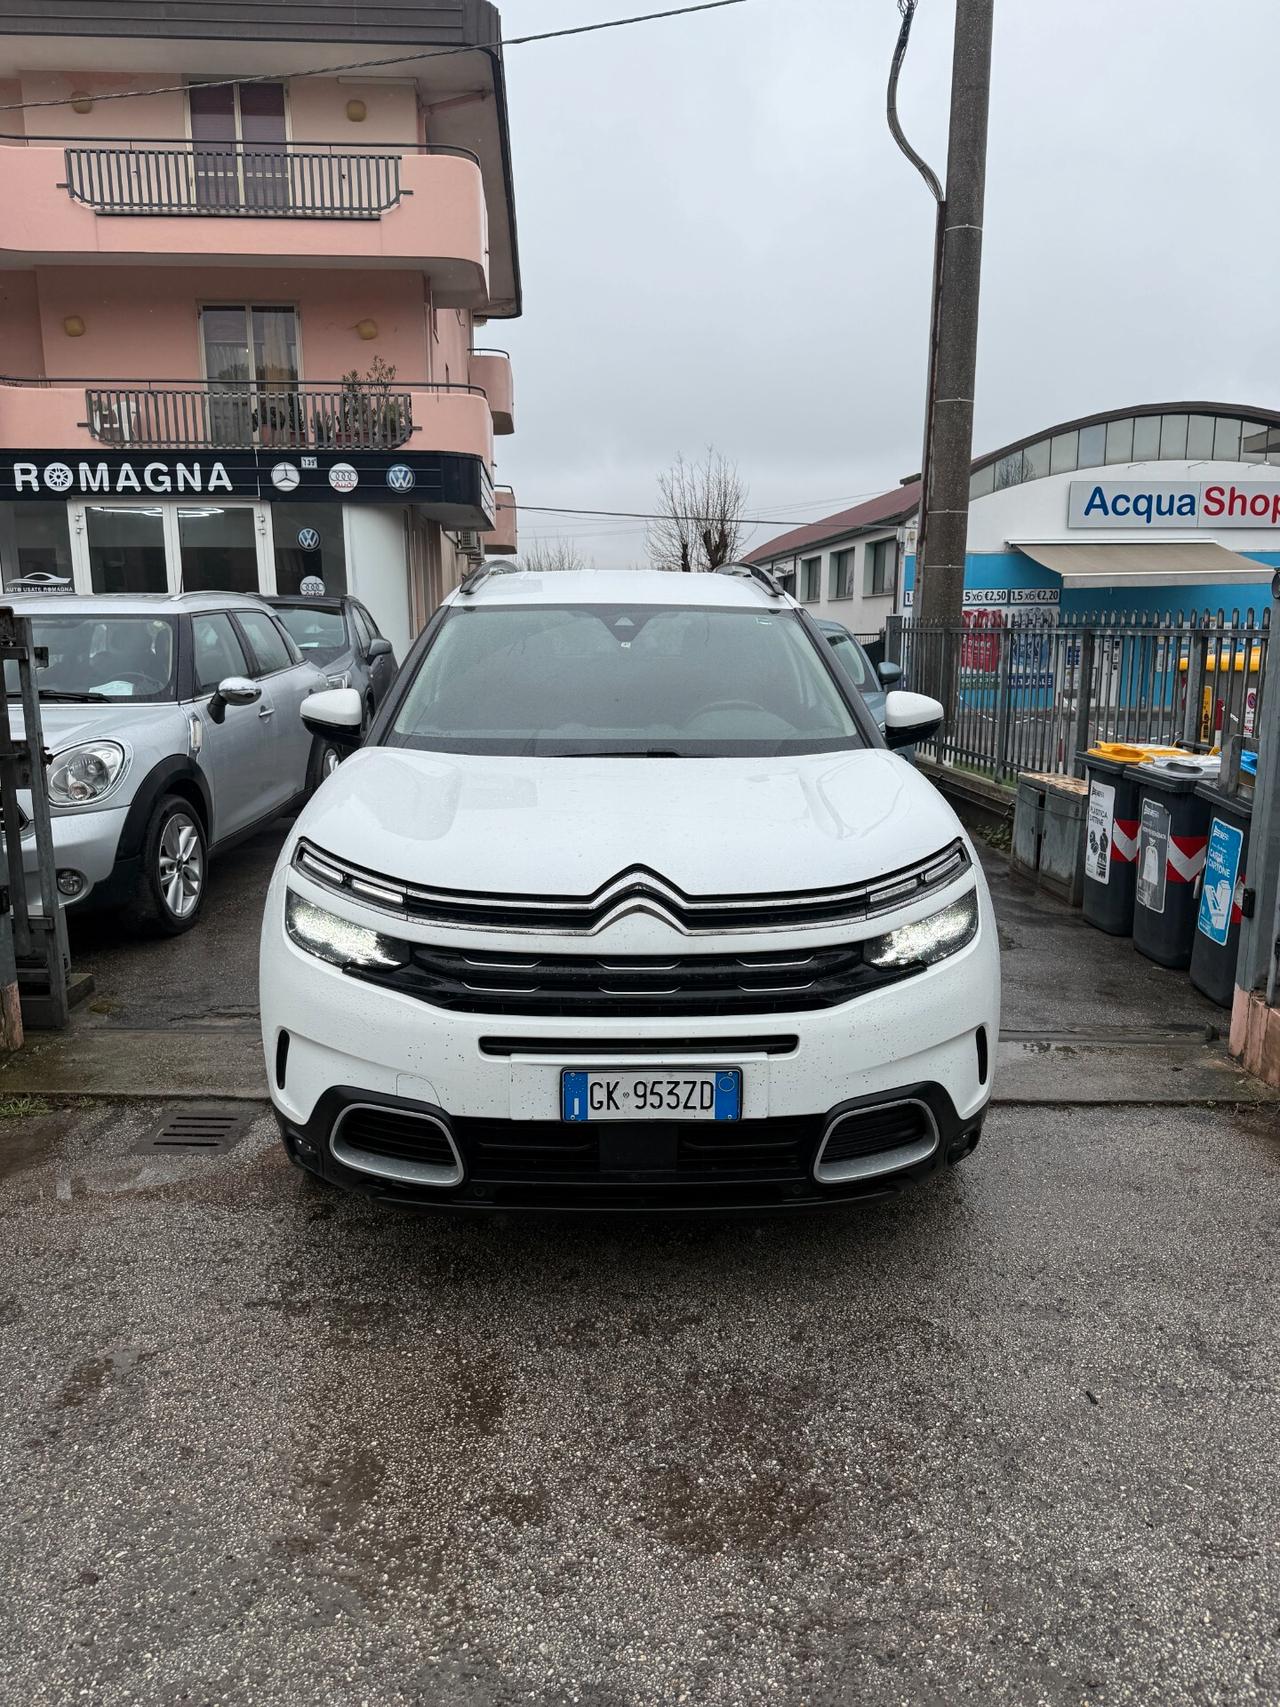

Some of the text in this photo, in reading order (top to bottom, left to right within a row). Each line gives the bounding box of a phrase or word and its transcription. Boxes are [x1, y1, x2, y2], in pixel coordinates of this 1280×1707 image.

[13, 462, 233, 492] ROMAGNA
[1084, 486, 1196, 524] Acqua
[972, 592, 983, 601] x6
[985, 591, 1006, 602] €2,50
[1012, 591, 1023, 602] 1,5
[1037, 590, 1058, 601] €2,20
[590, 1081, 714, 1110] GK 953ZD
